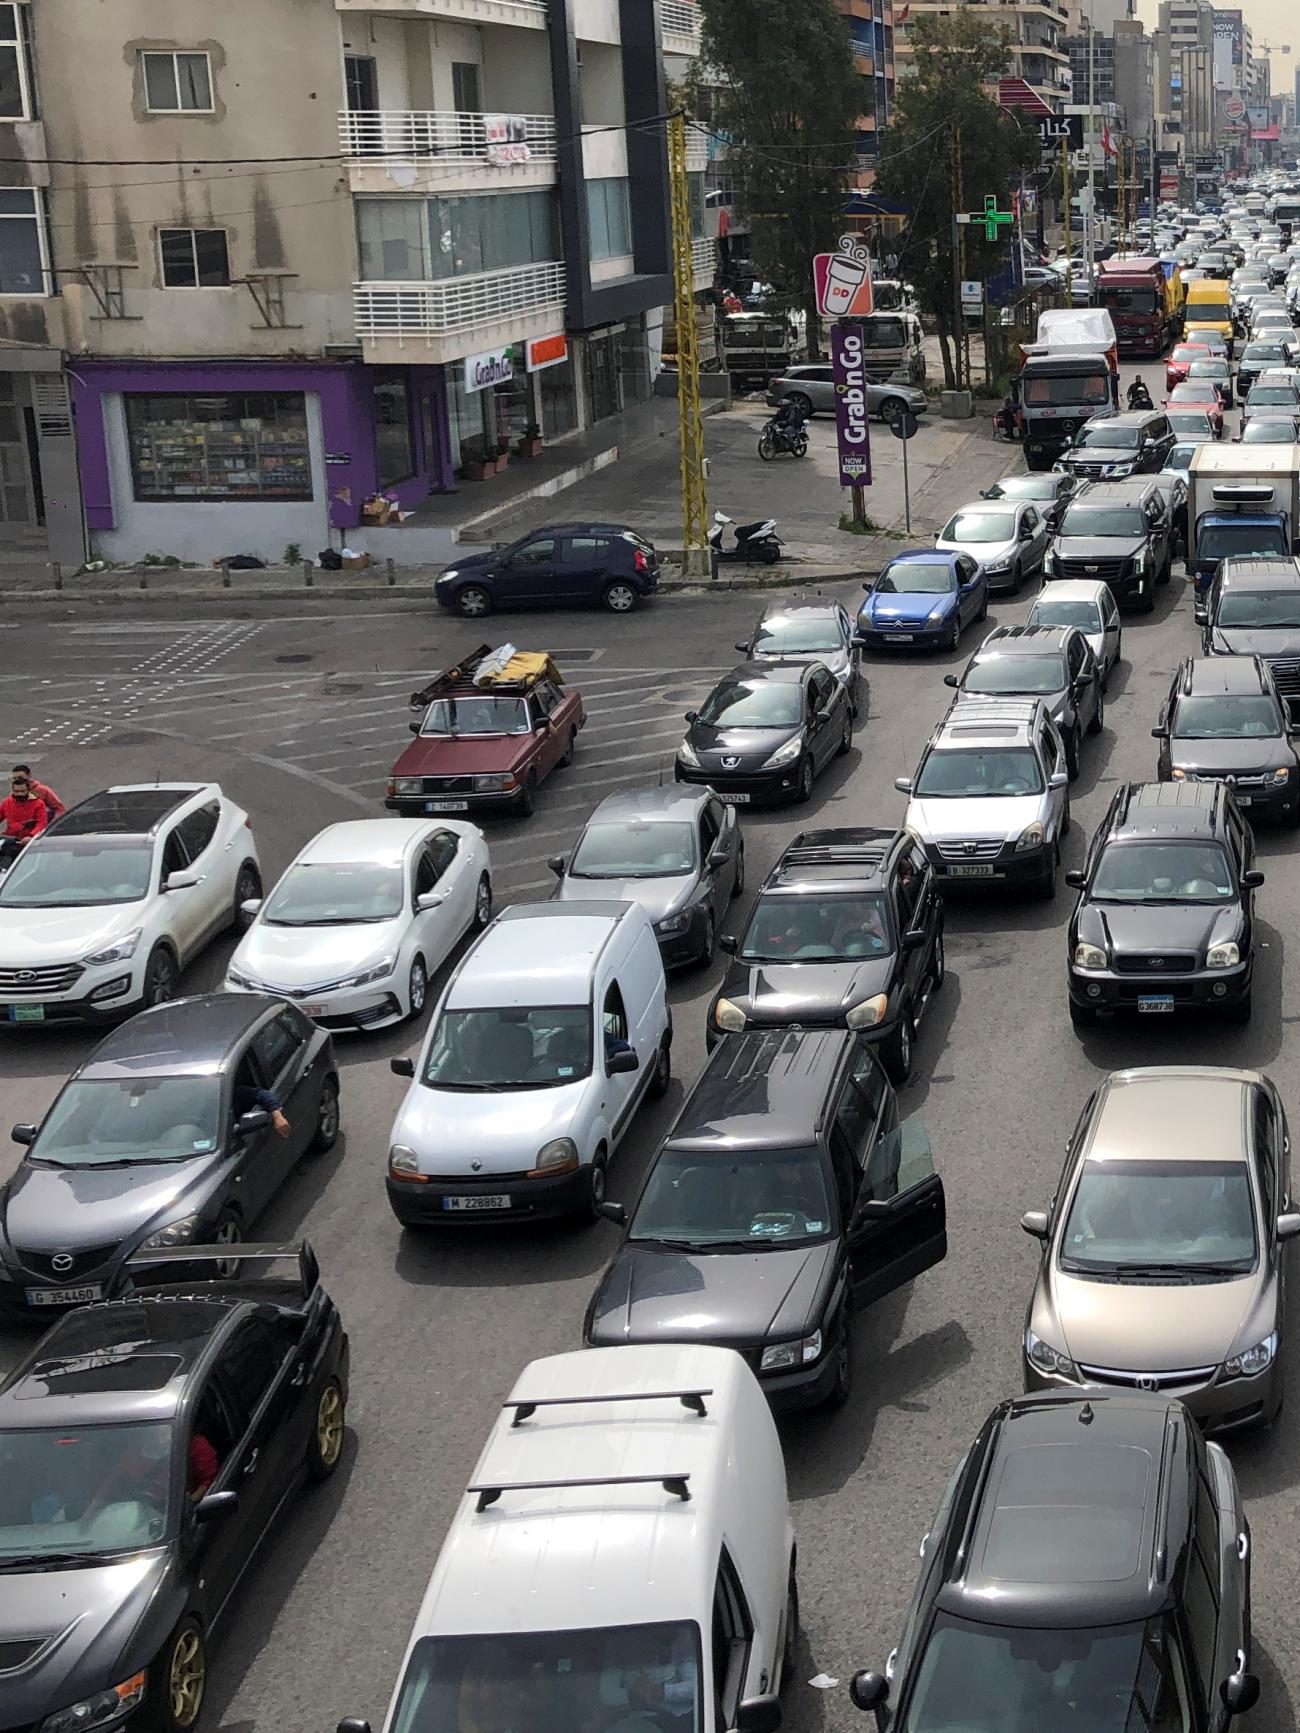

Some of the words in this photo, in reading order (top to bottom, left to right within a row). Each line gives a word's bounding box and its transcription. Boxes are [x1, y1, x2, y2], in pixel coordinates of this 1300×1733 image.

[832, 287, 849, 298] DD
[844, 457, 862, 465] NOW
[451, 1198, 460, 1208] M
[35, 1293, 44, 1303] G
